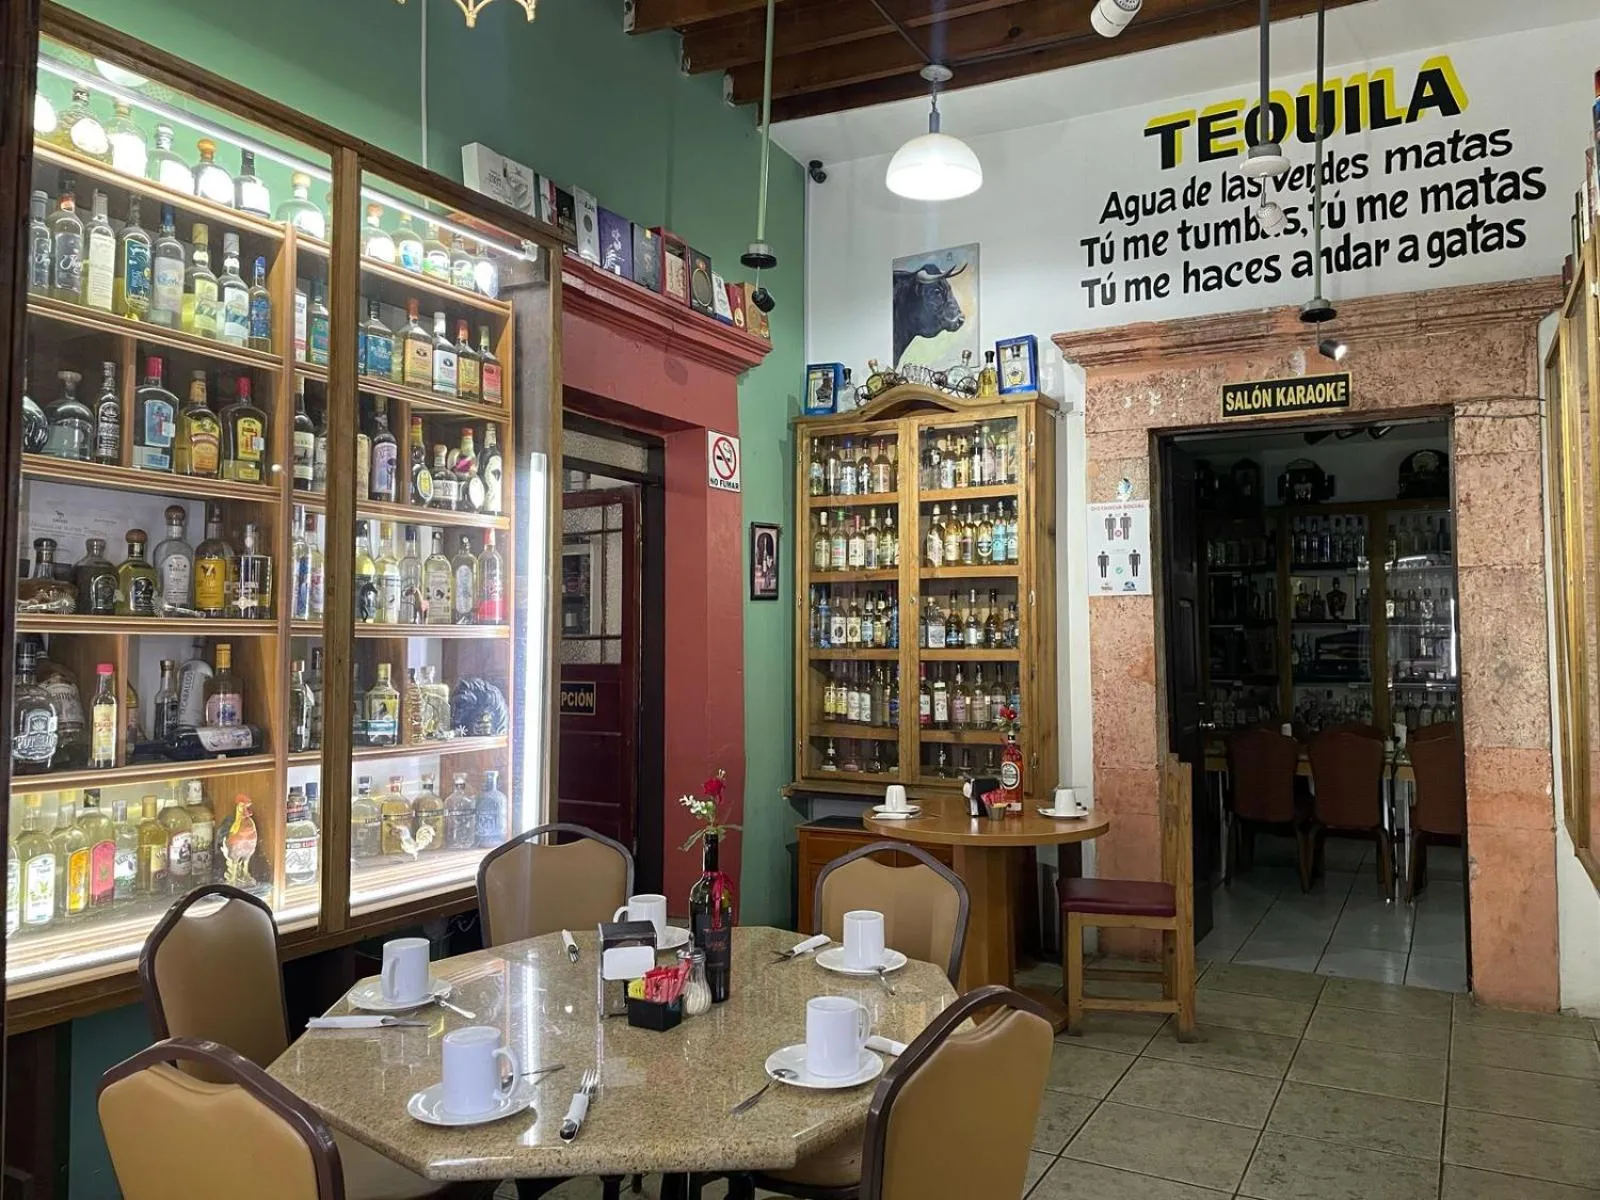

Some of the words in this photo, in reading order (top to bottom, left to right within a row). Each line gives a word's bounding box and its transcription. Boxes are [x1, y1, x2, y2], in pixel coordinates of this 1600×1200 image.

[1143, 56, 1468, 170] TEQUILA
[1080, 231, 1115, 267] Tú
[1123, 230, 1169, 262] me
[1177, 206, 1308, 251] tumbs,
[1308, 189, 1346, 233] tú
[1357, 189, 1409, 224] me
[1420, 166, 1547, 214] matas
[1100, 191, 1177, 226] Agua
[1182, 176, 1212, 210] de
[1222, 171, 1262, 203] las
[1271, 151, 1369, 194] verdes
[1385, 128, 1513, 175] matas
[1081, 272, 1116, 308] Tú
[1124, 273, 1170, 304] me
[1183, 254, 1282, 294] haces
[1397, 234, 1419, 263] a
[1427, 214, 1527, 268] gatas
[1226, 384, 1272, 411] SALÓN
[1276, 381, 1346, 407] KARAOKE
[710, 477, 719, 486] NO
[719, 479, 739, 489] FUMAR
